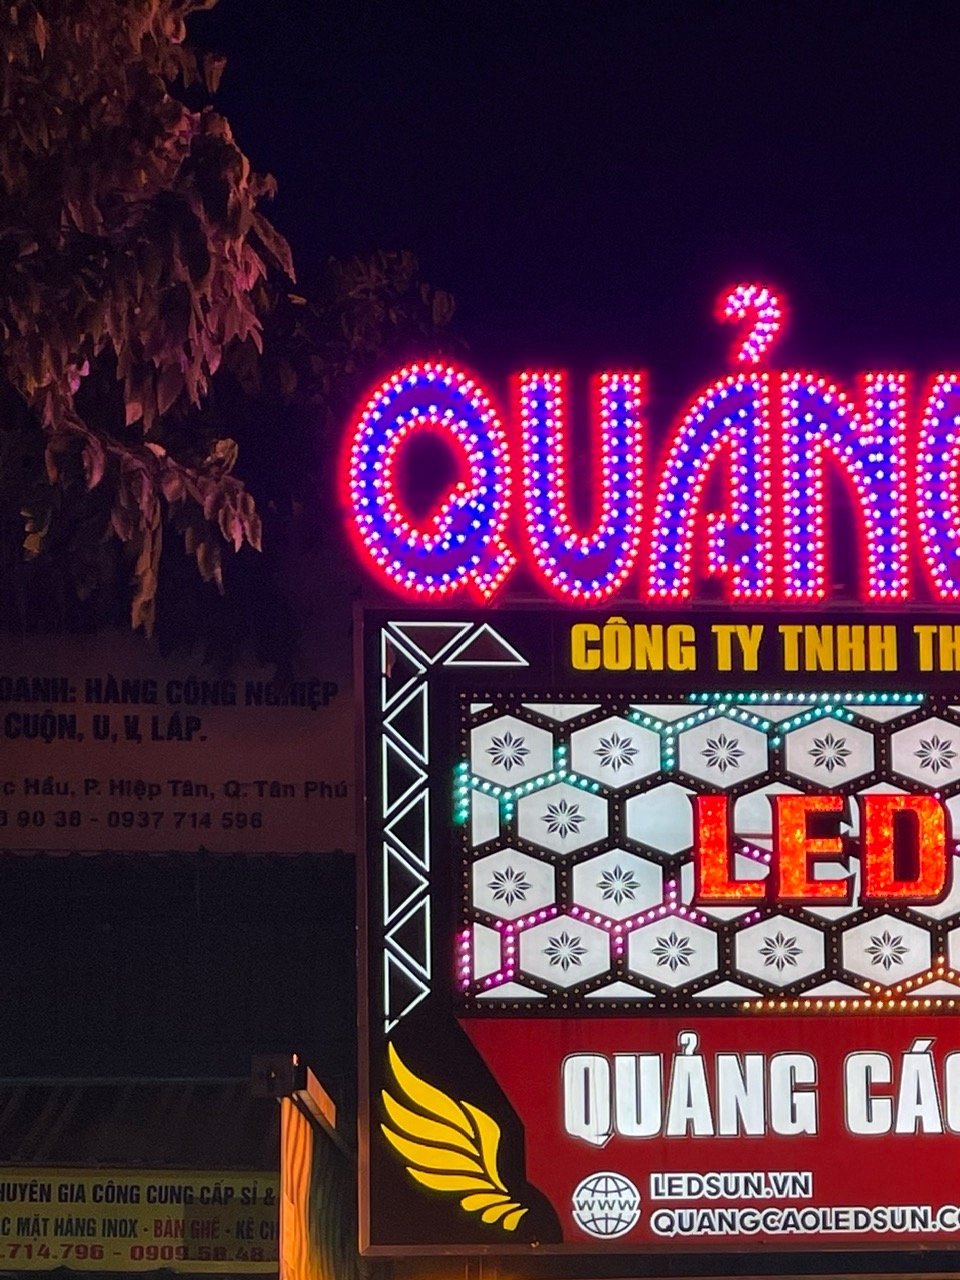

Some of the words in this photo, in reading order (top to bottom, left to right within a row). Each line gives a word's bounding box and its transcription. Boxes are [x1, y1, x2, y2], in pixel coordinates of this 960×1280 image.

[571, 616, 697, 671] CÔNG
[711, 624, 764, 671] TY
[778, 624, 898, 672] TNHH
[85, 673, 158, 704] HÀNG
[166, 674, 236, 706] CÔNG
[253, 779, 296, 798] Tân
[304, 780, 348, 799] Phú
[107, 810, 163, 830] 0937
[174, 811, 212, 830] 714
[690, 793, 953, 906] LED
[562, 1029, 820, 1149] QUẢNG
[58, 1183, 87, 1204] GIA
[92, 1179, 141, 1205] CÔNG
[146, 1184, 194, 1206] CUNG
[199, 1178, 235, 1206] CẤP
[263, 1186, 276, 1206] &
[650, 1171, 813, 1200] LEDSUN.VN
[17, 1213, 50, 1242] MẶT
[54, 1213, 97, 1238] HÀNG
[102, 1217, 138, 1239] INOX
[154, 1214, 185, 1239] BÀN
